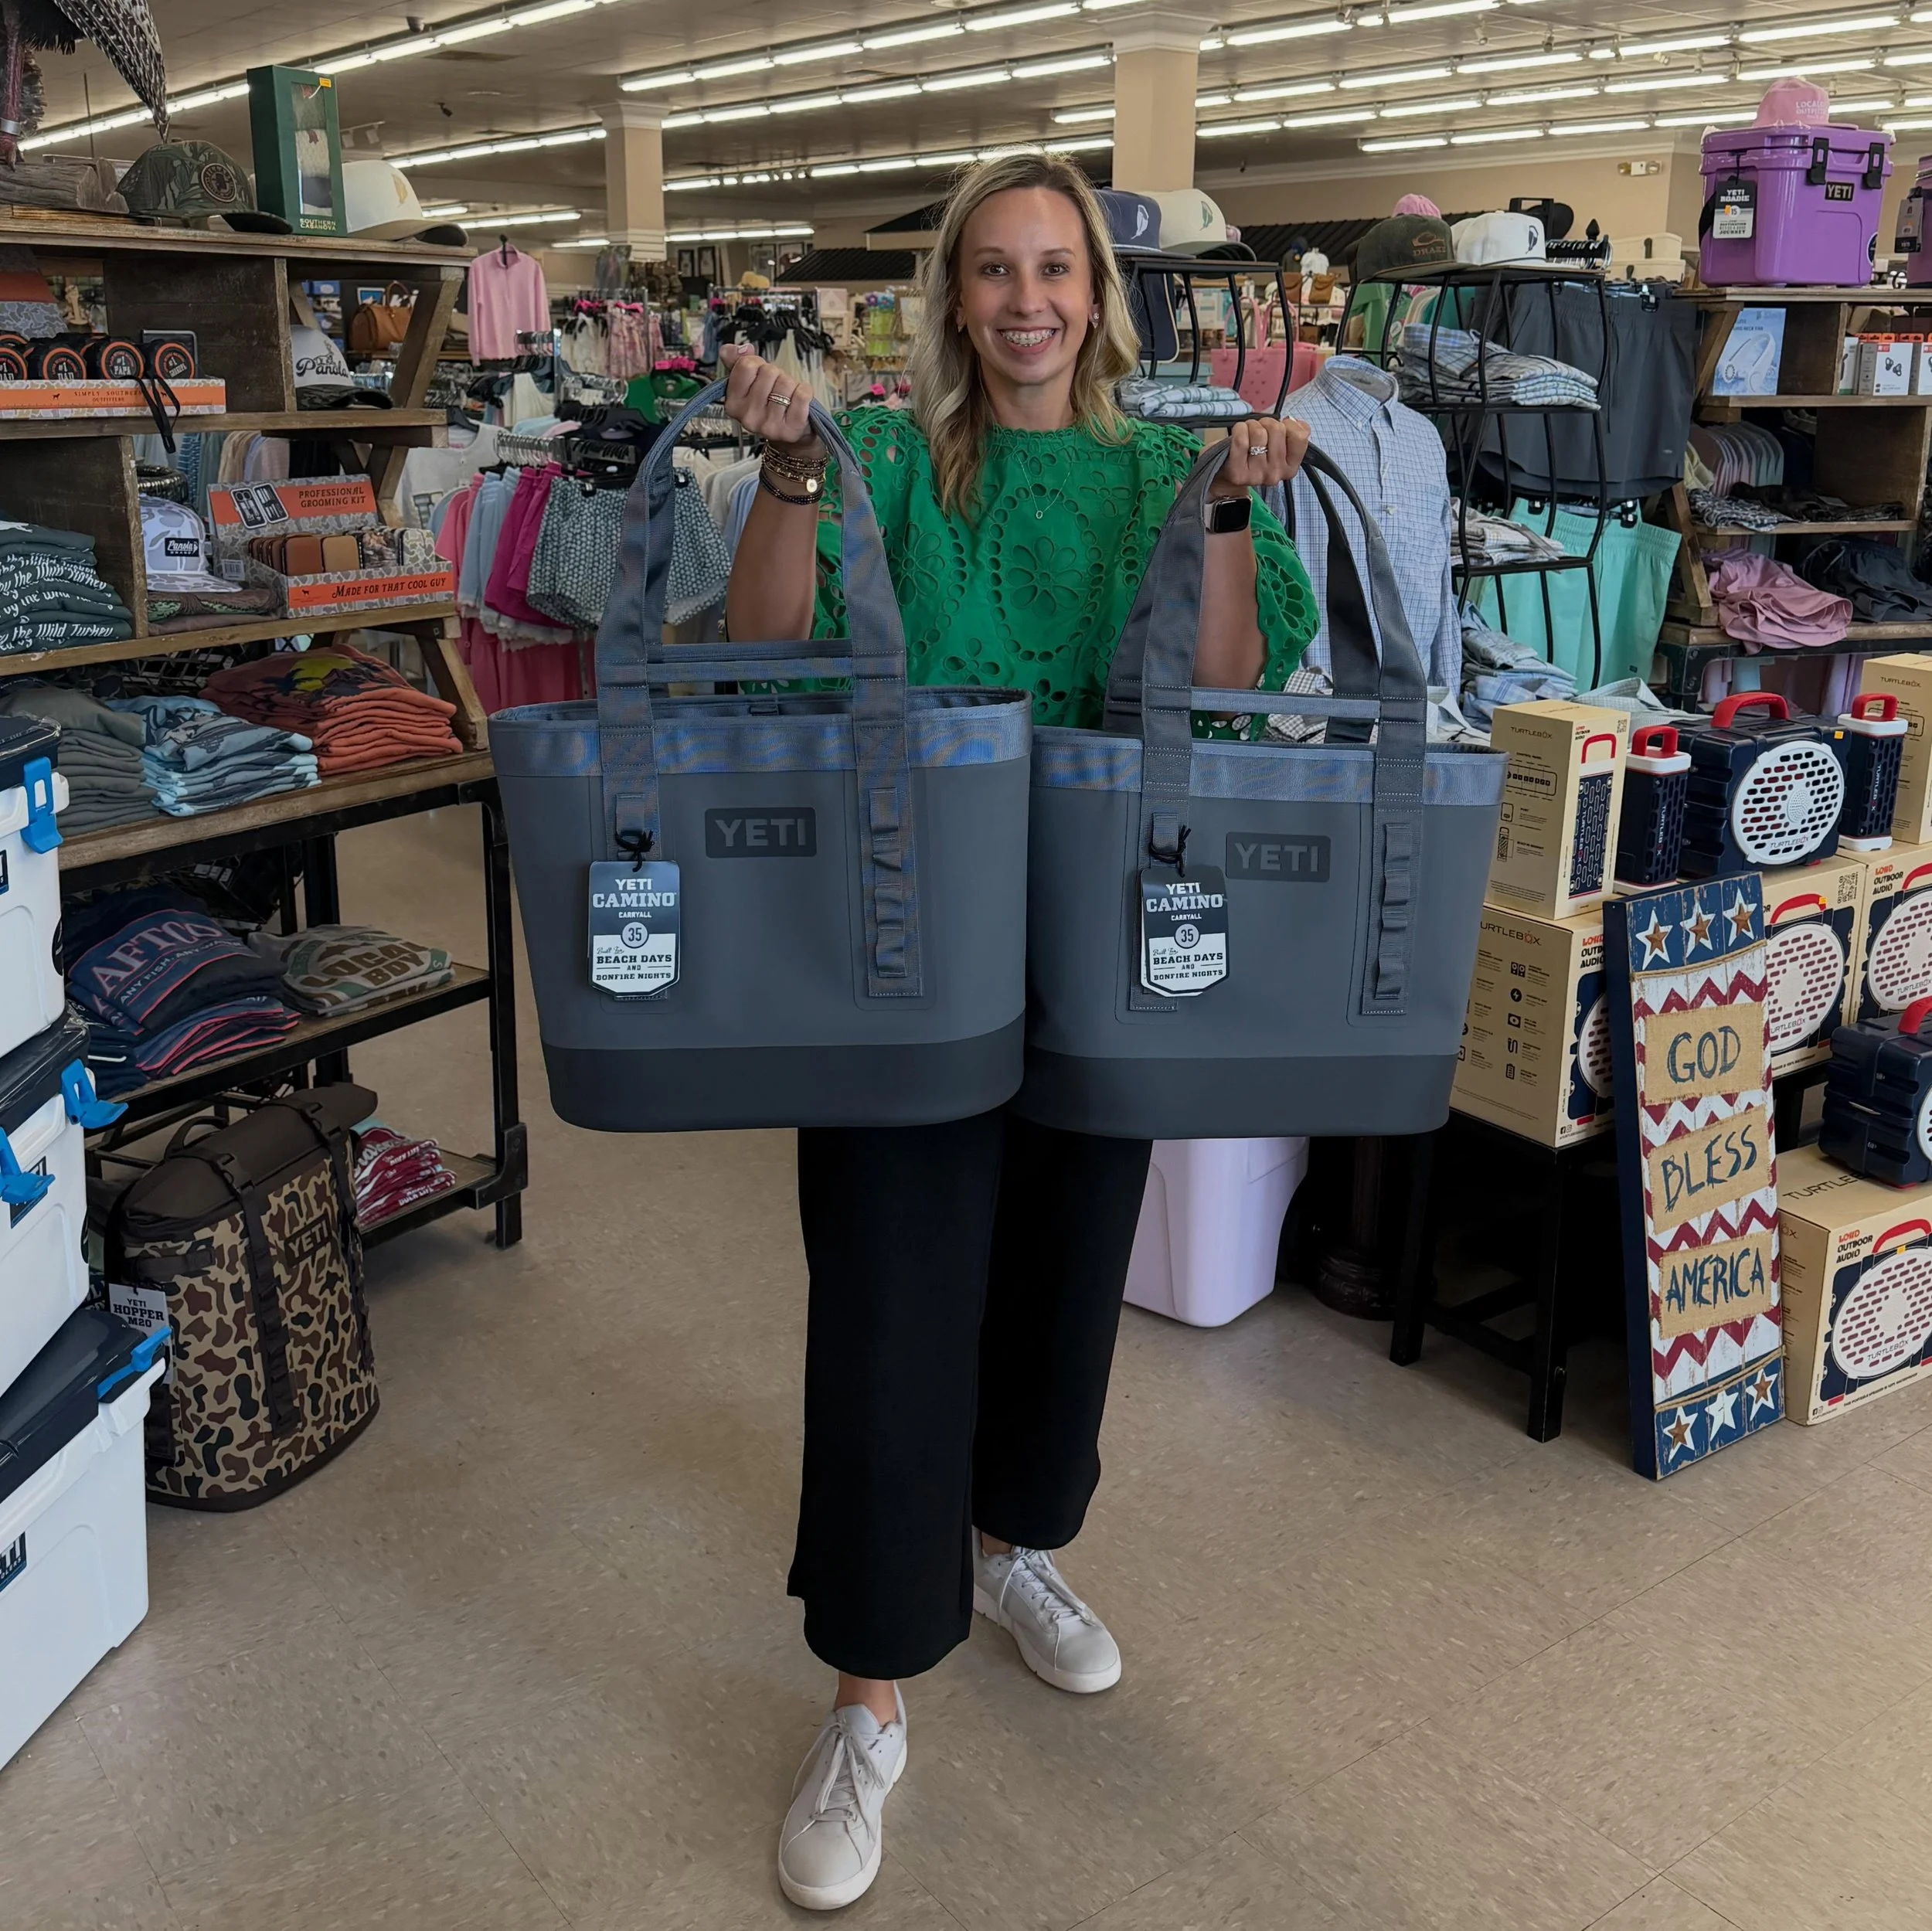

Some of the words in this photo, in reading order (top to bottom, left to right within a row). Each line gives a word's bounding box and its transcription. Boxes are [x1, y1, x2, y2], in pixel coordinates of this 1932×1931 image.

[1828, 185, 1852, 199] YETI
[58, 362, 68, 372] #1
[117, 356, 125, 365] #1
[168, 357, 177, 366] #1
[114, 365, 131, 376] PAPA
[298, 487, 364, 499] PROFESSIONAL
[301, 497, 349, 508] GROOMING
[350, 495, 366, 505] KIT
[382, 581, 406, 593] THAT
[407, 580, 427, 590] COOL
[430, 577, 447, 587] GUY
[12, 626, 32, 641] the
[36, 623, 67, 637] Wild
[70, 624, 114, 637] Turkey
[1880, 676, 1921, 688] TURTLEBOX
[1510, 726, 1553, 739] TURTLEBOX
[1870, 764, 1882, 811] TURTLEBOX
[714, 819, 806, 847] YETI
[1577, 810, 1587, 862] TURTLEBOX
[1657, 805, 1666, 856] TURTLEBOX
[1770, 835, 1809, 848] TURTLEBOX
[1235, 842, 1318, 872] YETI
[1875, 865, 1893, 875] LOUD
[615, 879, 652, 890] YETI
[1873, 871, 1903, 886] OUTDOOR
[1165, 882, 1201, 895] YETI
[1872, 883, 1893, 895] AUDIO
[593, 892, 675, 909] CAMINO
[1146, 893, 1224, 913] CAMINO
[628, 927, 642, 942] 35
[1181, 929, 1193, 943] 35
[1479, 920, 1542, 946] URTLEBOX
[91, 920, 223, 997] AFTCO
[596, 955, 638, 964] BEACH
[641, 954, 672, 964] DAYS
[1153, 955, 1191, 965] BEACH
[1194, 952, 1223, 962] DAYS
[1580, 947, 1604, 957] OUTD
[121, 980, 142, 1005] ANY
[175, 947, 199, 958] ANY
[596, 973, 635, 981] BONFIRE
[1154, 971, 1190, 981] BONFIRE
[1192, 969, 1223, 978] NIGHTS
[1770, 1017, 1806, 1034] URTLEBOX
[1667, 1025, 1741, 1083] GOD
[1661, 1124, 1757, 1213] BLESS
[288, 1219, 328, 1258] YETI
[1838, 1229, 1860, 1243] LOUD
[1837, 1235, 1872, 1253] OUTDOOR
[1836, 1249, 1860, 1264] AUDIO
[1665, 1247, 1765, 1314] AMERICA
[127, 1298, 146, 1307] YETI
[113, 1304, 165, 1321] HOPPER
[128, 1318, 152, 1328] M20
[1867, 1338, 1910, 1362] TURTLEBOX
